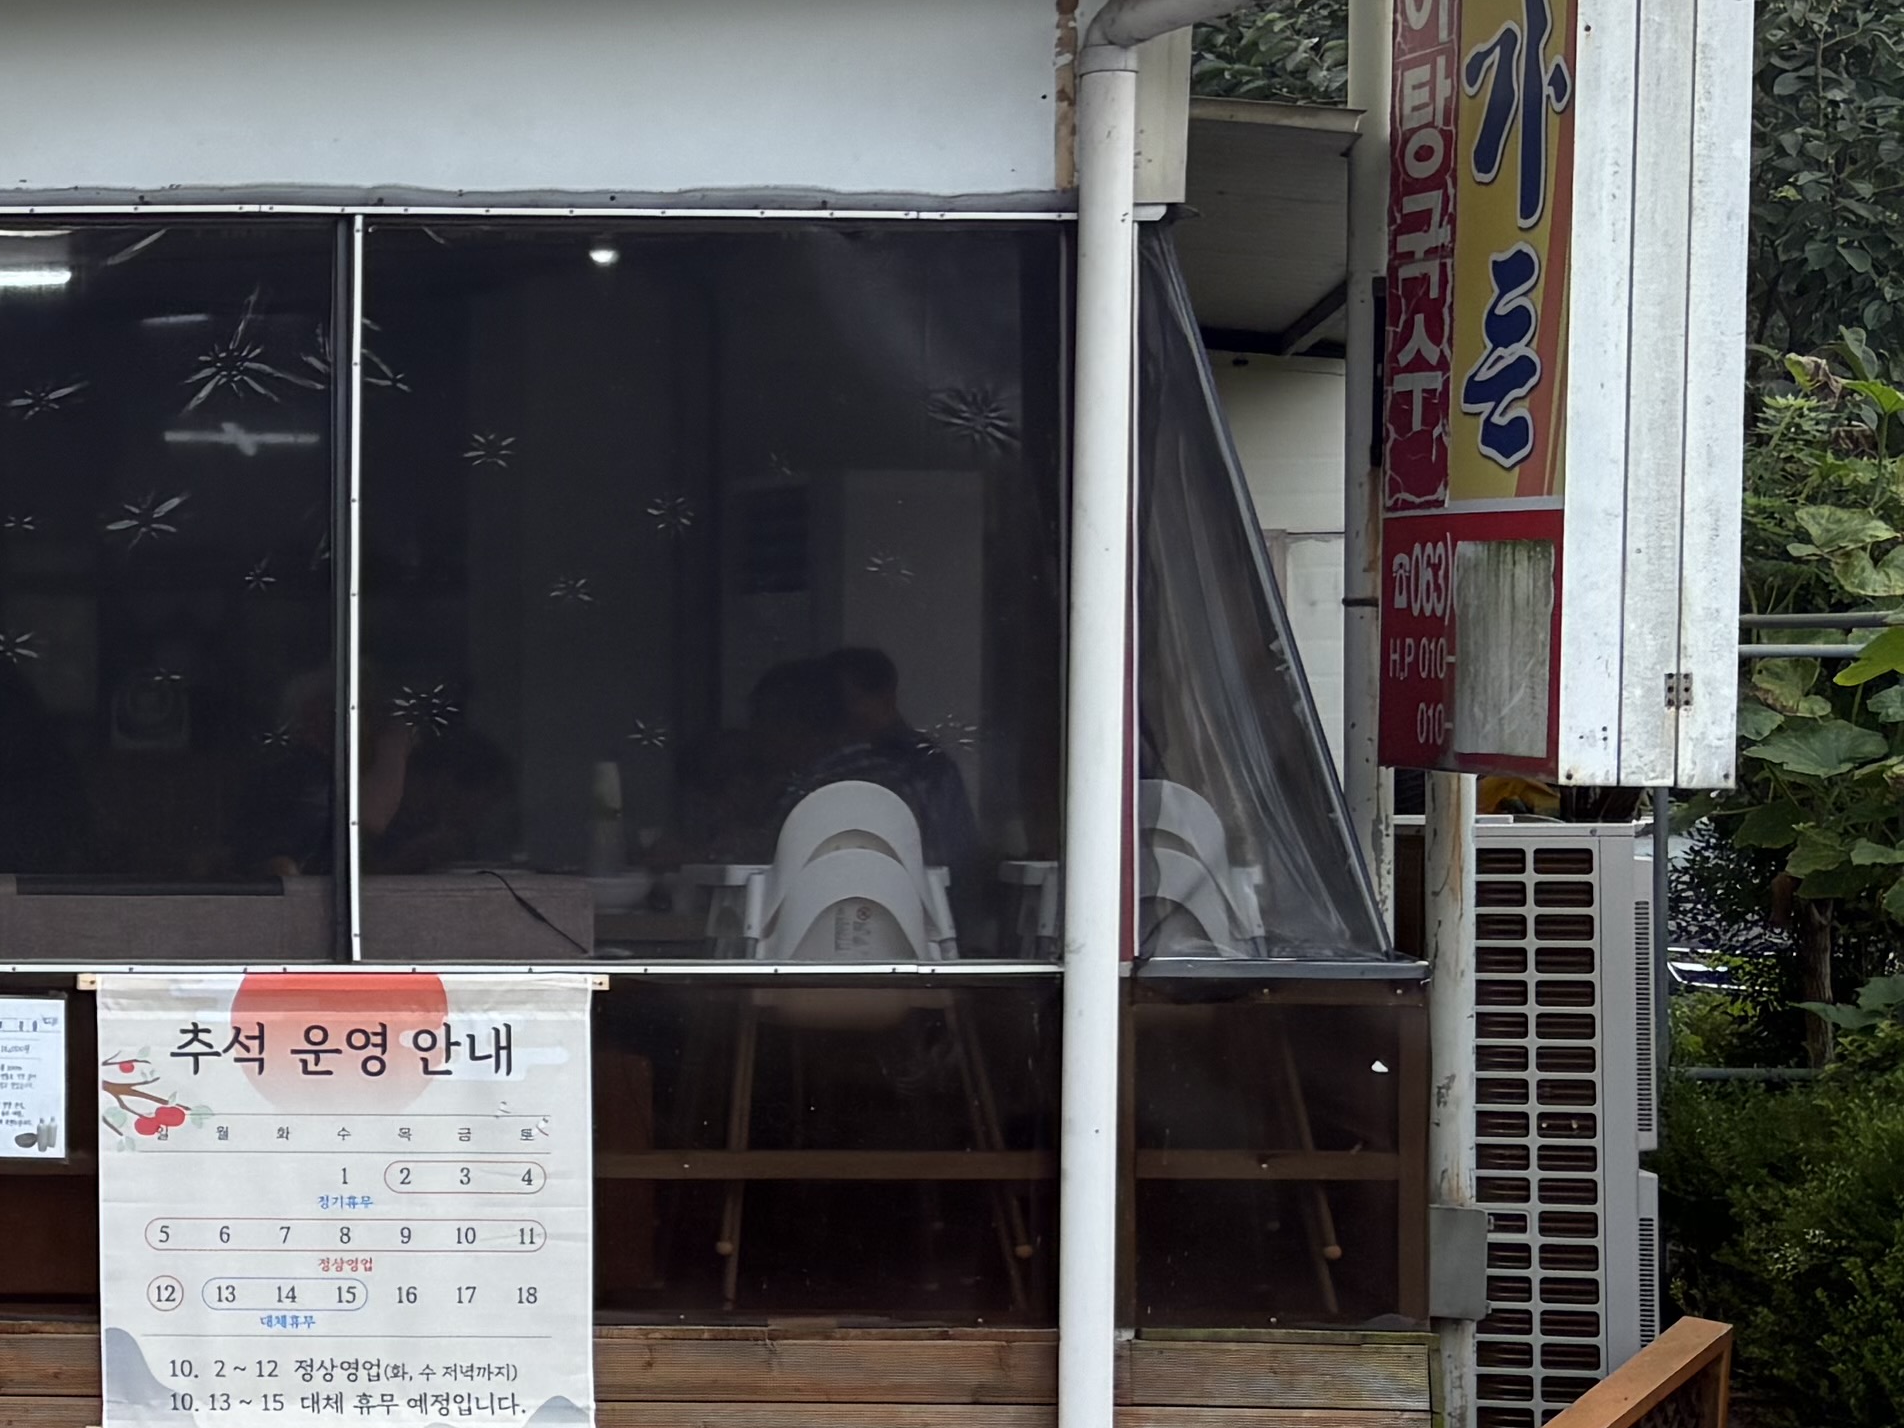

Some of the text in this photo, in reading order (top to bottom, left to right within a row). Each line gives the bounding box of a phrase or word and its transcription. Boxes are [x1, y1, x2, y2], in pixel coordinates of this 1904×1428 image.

[169, 1022, 514, 1077] 추석 운영 안내
[341, 1167, 533, 1186] 1 2 3 4
[317, 1194, 374, 1209] 정기휴무
[158, 1225, 536, 1245] 5 6 7 8 9 10 11
[317, 1256, 373, 1272] 정상영업
[156, 1284, 538, 1305] 12 13 14 15 16 17 18
[259, 1315, 316, 1329] 대체휴무
[169, 1359, 199, 1379] 10.
[214, 1359, 226, 1378] 2
[256, 1359, 279, 1378] 12
[170, 1392, 199, 1412] 10.
[208, 1392, 231, 1411] 13
[261, 1393, 285, 1412] 15
[299, 1393, 344, 1415] 대체
[352, 1393, 399, 1415] 휴무
[406, 1393, 526, 1416] 예정입니다.
